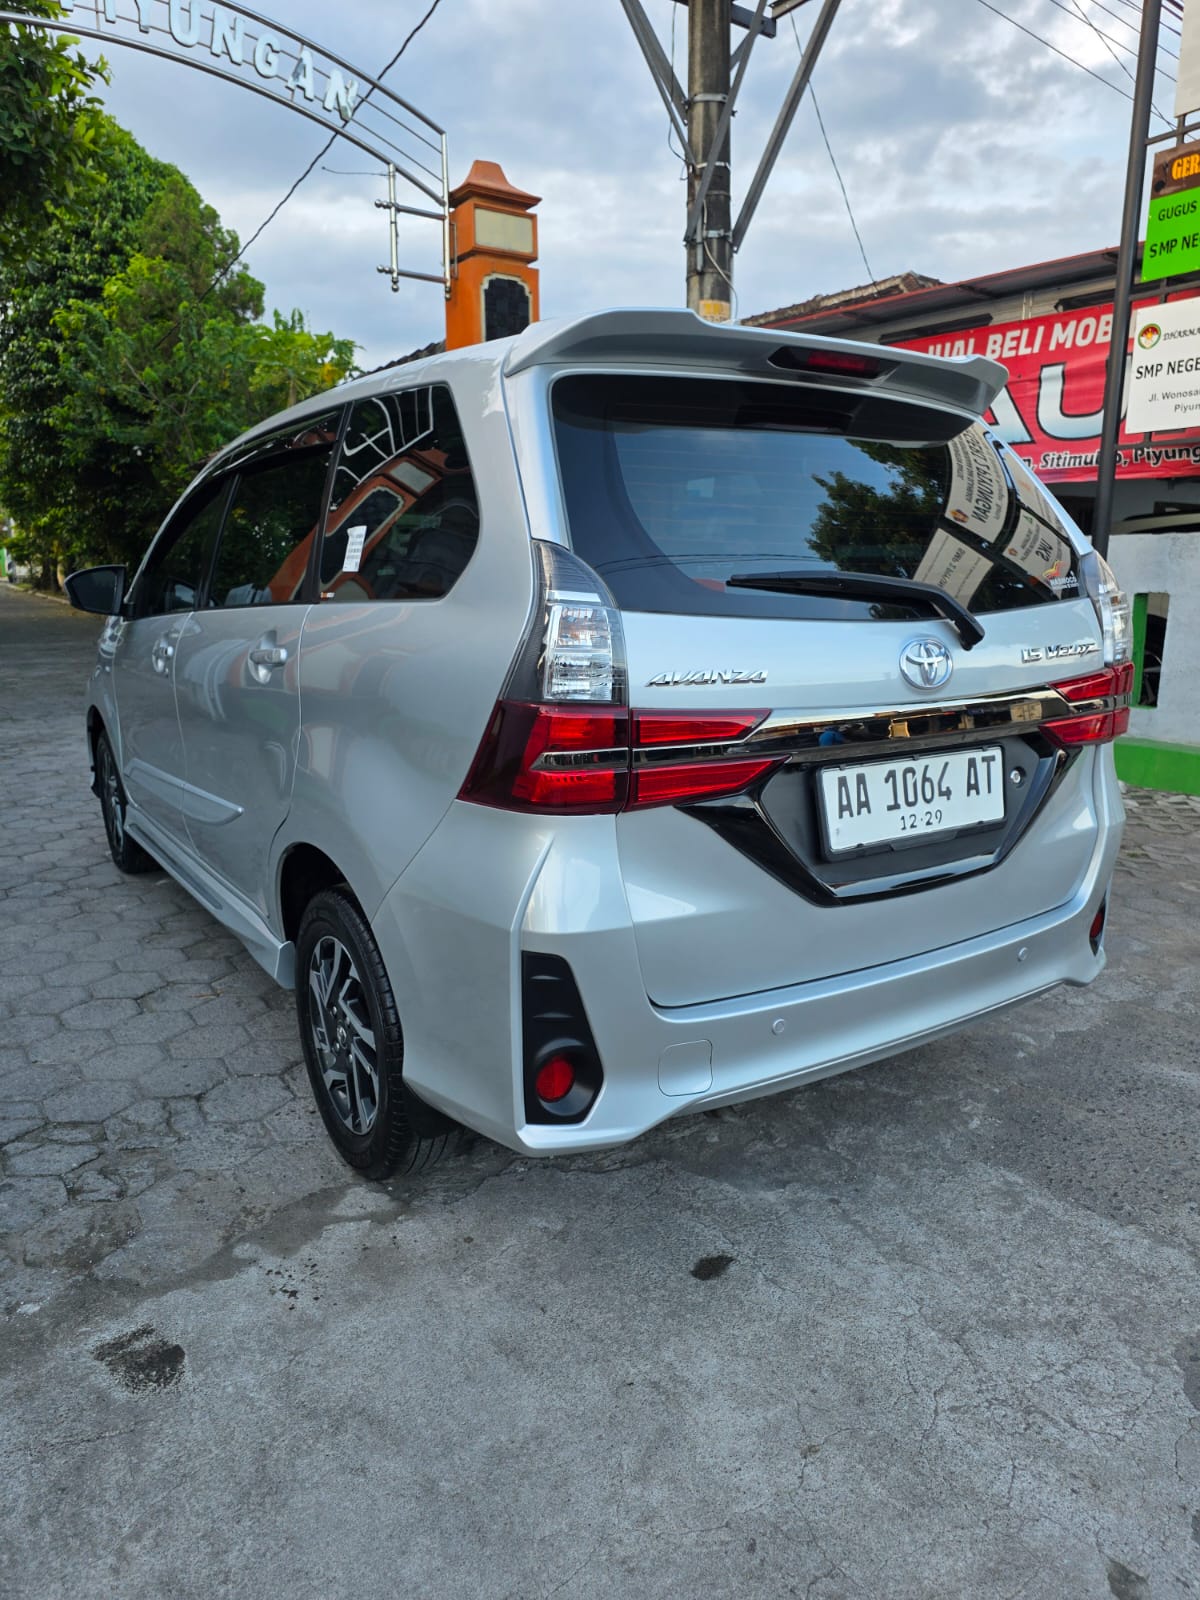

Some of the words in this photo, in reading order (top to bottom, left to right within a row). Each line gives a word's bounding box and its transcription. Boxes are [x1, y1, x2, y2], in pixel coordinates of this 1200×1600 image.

[60, 0, 361, 122] IYUNGAN
[1158, 200, 1198, 221] GUGUS
[1149, 238, 1177, 258] SMP
[1181, 232, 1200, 250] NE
[985, 326, 1044, 360] BELI
[1136, 363, 1163, 379] SMP
[645, 669, 768, 687] AVANZA
[837, 771, 872, 819] AA
[884, 762, 953, 811] 1064
[966, 755, 996, 797] AT
